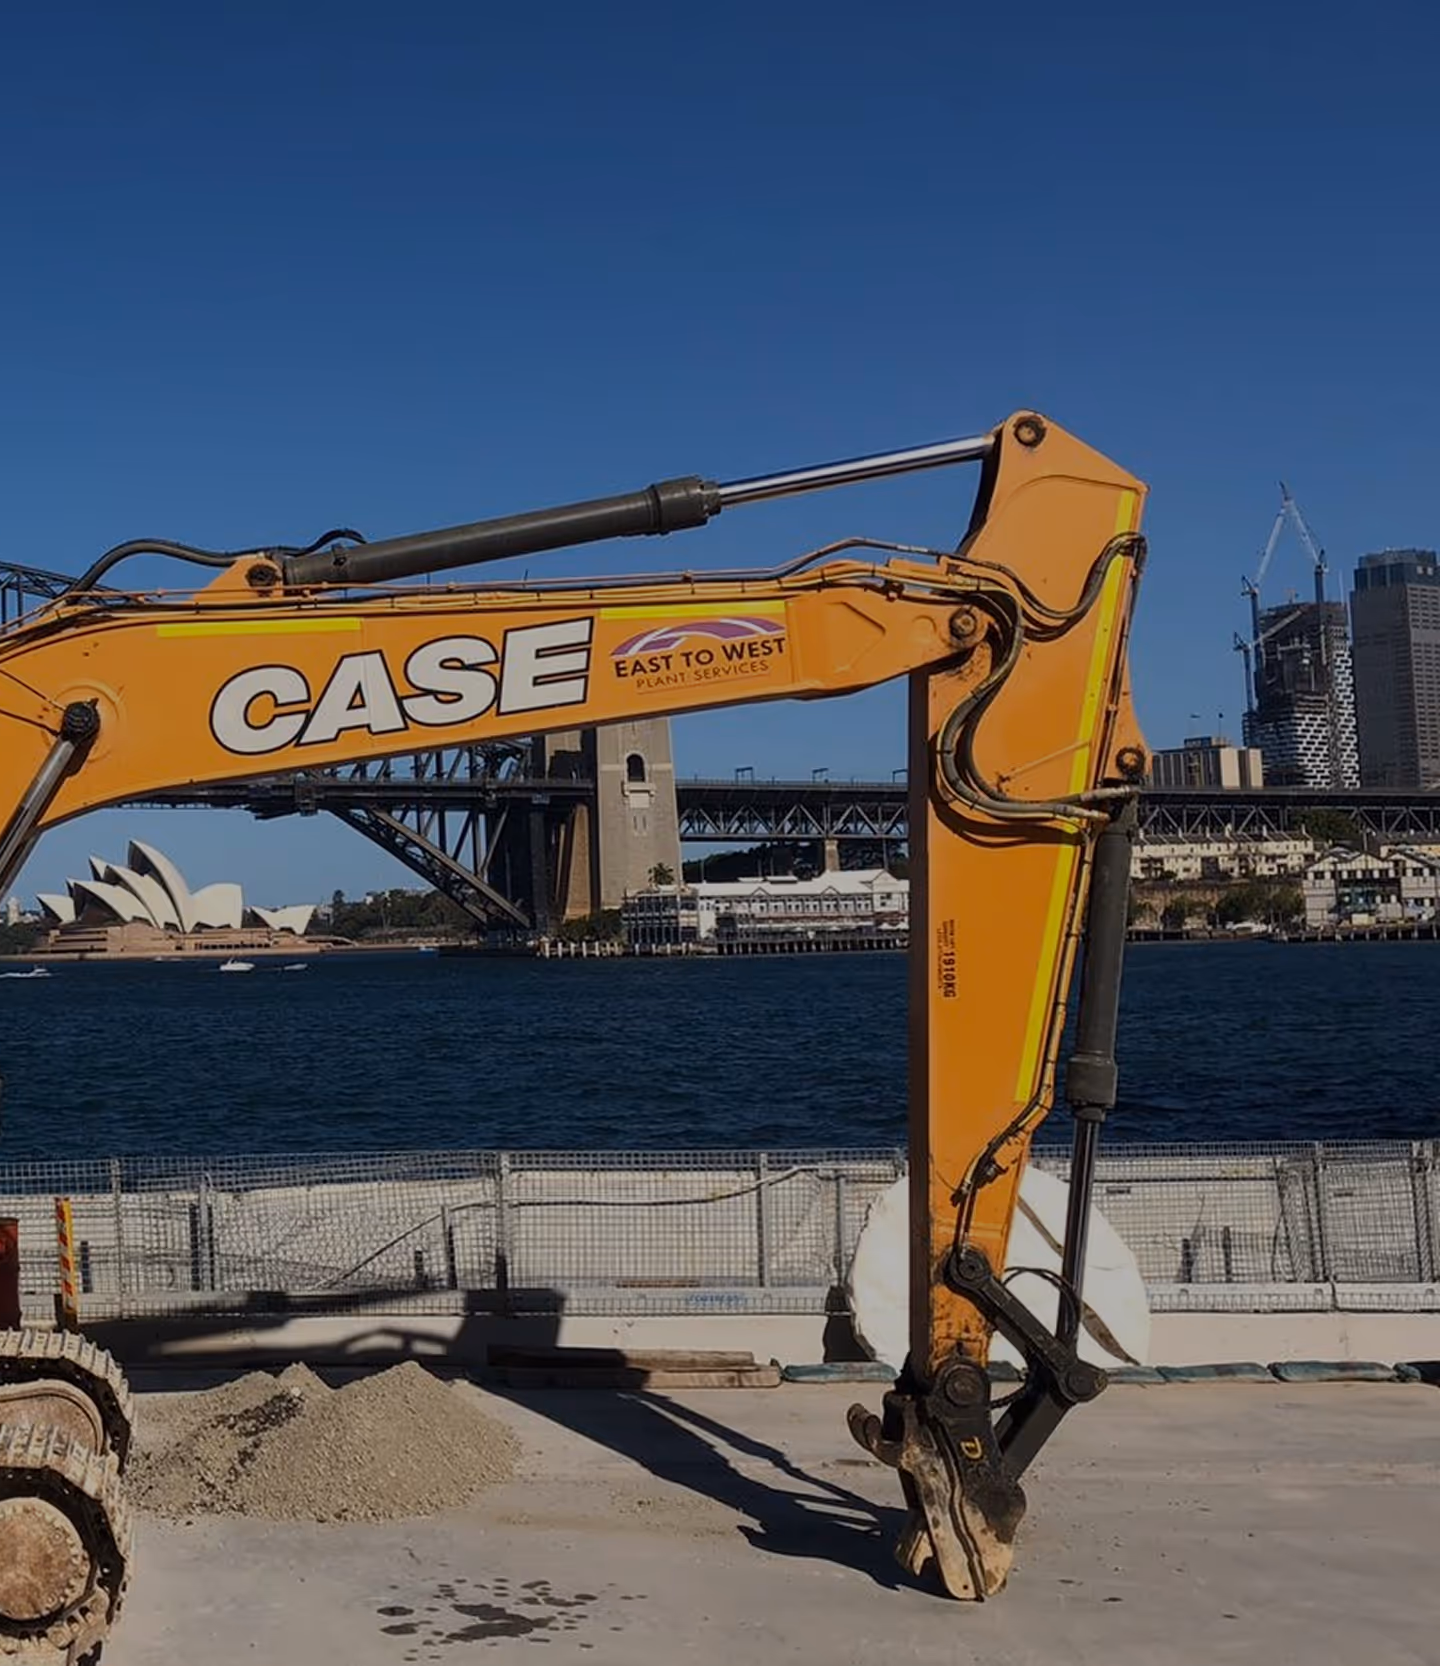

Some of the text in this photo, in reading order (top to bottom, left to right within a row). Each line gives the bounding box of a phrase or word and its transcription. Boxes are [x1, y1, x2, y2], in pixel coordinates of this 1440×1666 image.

[614, 637, 786, 678] EAST TO WEST
[636, 660, 770, 689] PLANT SERVICES
[209, 616, 594, 756] CASE
